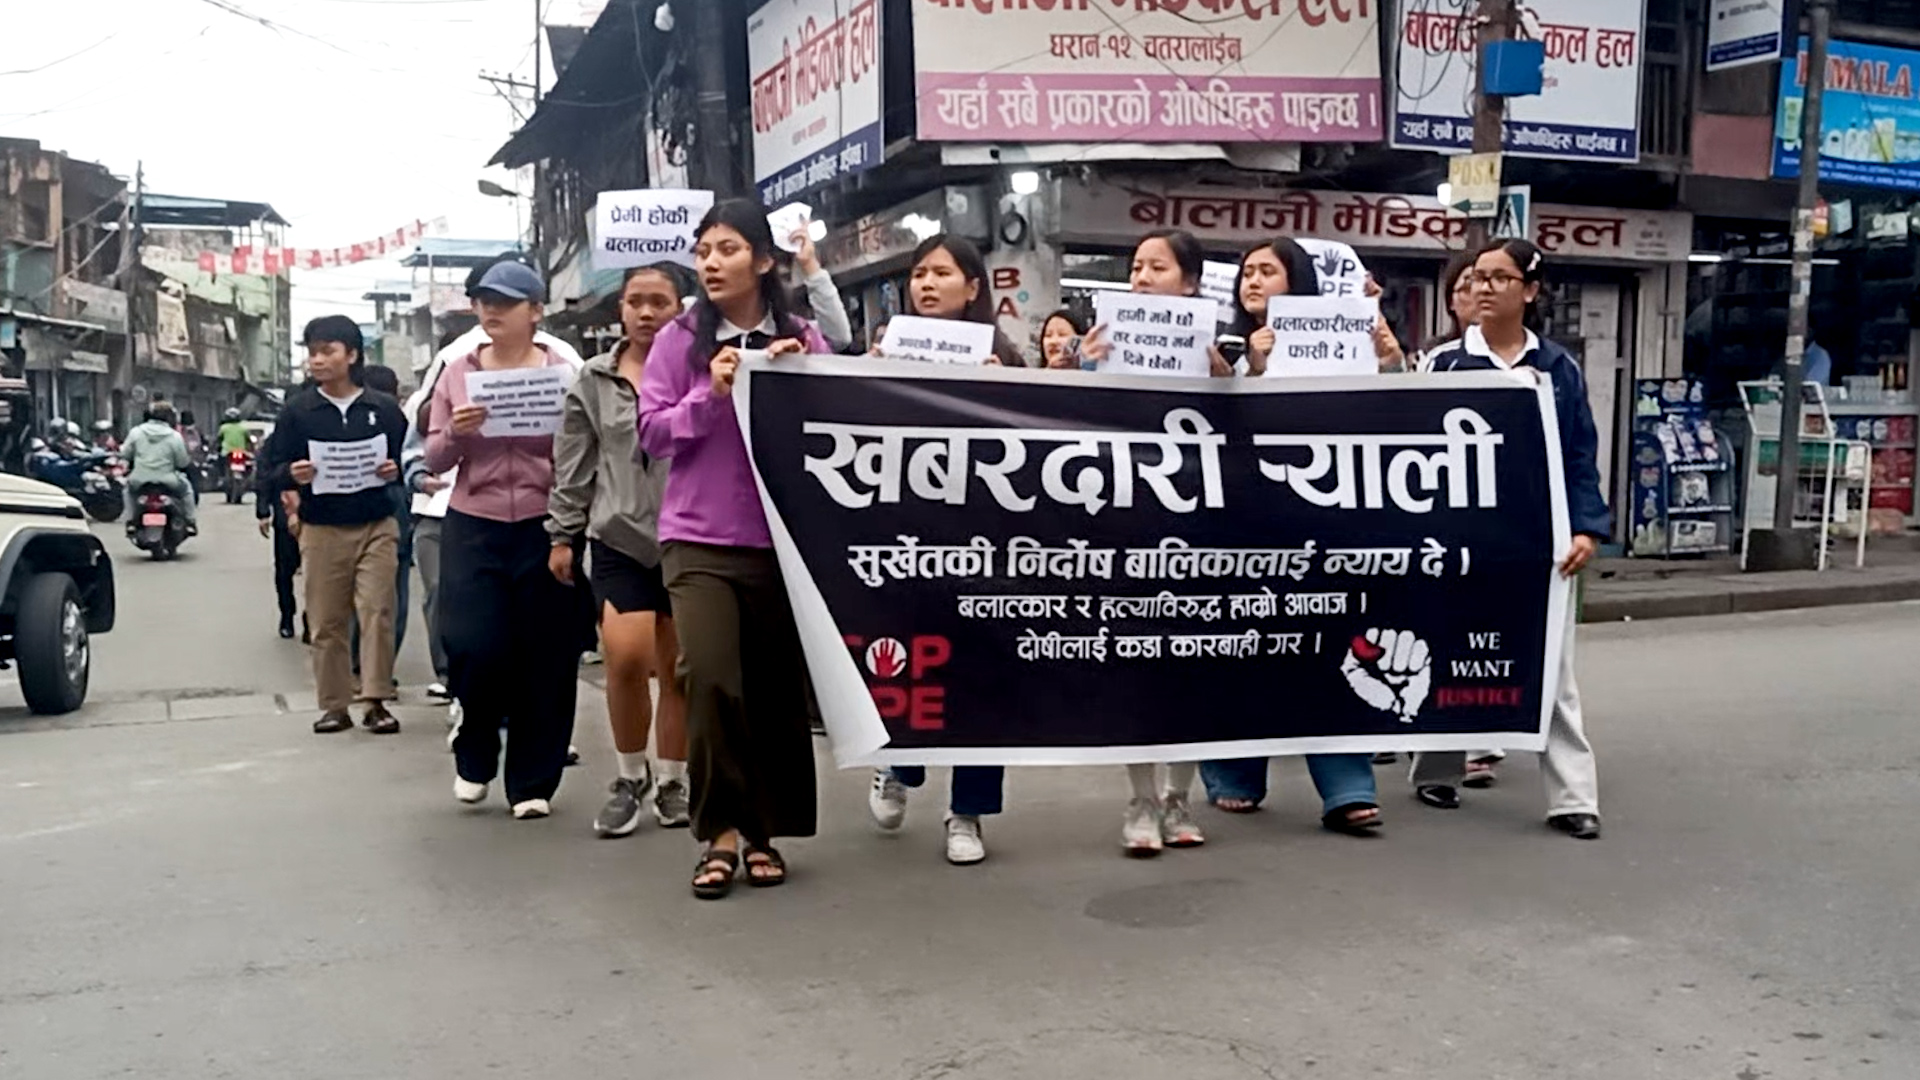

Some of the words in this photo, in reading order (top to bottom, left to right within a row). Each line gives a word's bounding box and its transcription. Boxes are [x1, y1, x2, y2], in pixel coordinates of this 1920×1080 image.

[1596, 29, 1635, 68] हल
[936, 76, 991, 131] यहाँ
[998, 75, 1040, 128] सबै
[1046, 78, 1151, 132] प्रकारको
[611, 205, 642, 224] प्रेमी
[1130, 192, 1322, 231] बालाजी
[1333, 194, 1467, 240] मेडिक
[1536, 213, 1627, 252] हल
[1289, 341, 1328, 359] फासी
[803, 407, 1226, 515] खबरदारी
[848, 534, 996, 587] सुर्खेतकी
[1007, 536, 1116, 580] निर्दोष
[1125, 536, 1317, 581] बालिकालाई
[1323, 547, 1413, 577] न्याय
[1420, 537, 1448, 577] दे
[957, 594, 1068, 619] बलात्कार
[1074, 594, 1093, 618] र
[1100, 590, 1222, 622] हत्याविरुद्ध
[1228, 586, 1277, 619] हाम्रो
[1284, 592, 1348, 616] आवाज
[1016, 627, 1109, 662] दोषीलाई
[1114, 635, 1162, 659] कडा
[1169, 628, 1261, 659] कारबाही
[1266, 633, 1304, 655] गर
[1468, 632, 1501, 650] WE
[1451, 660, 1515, 678] WANT
